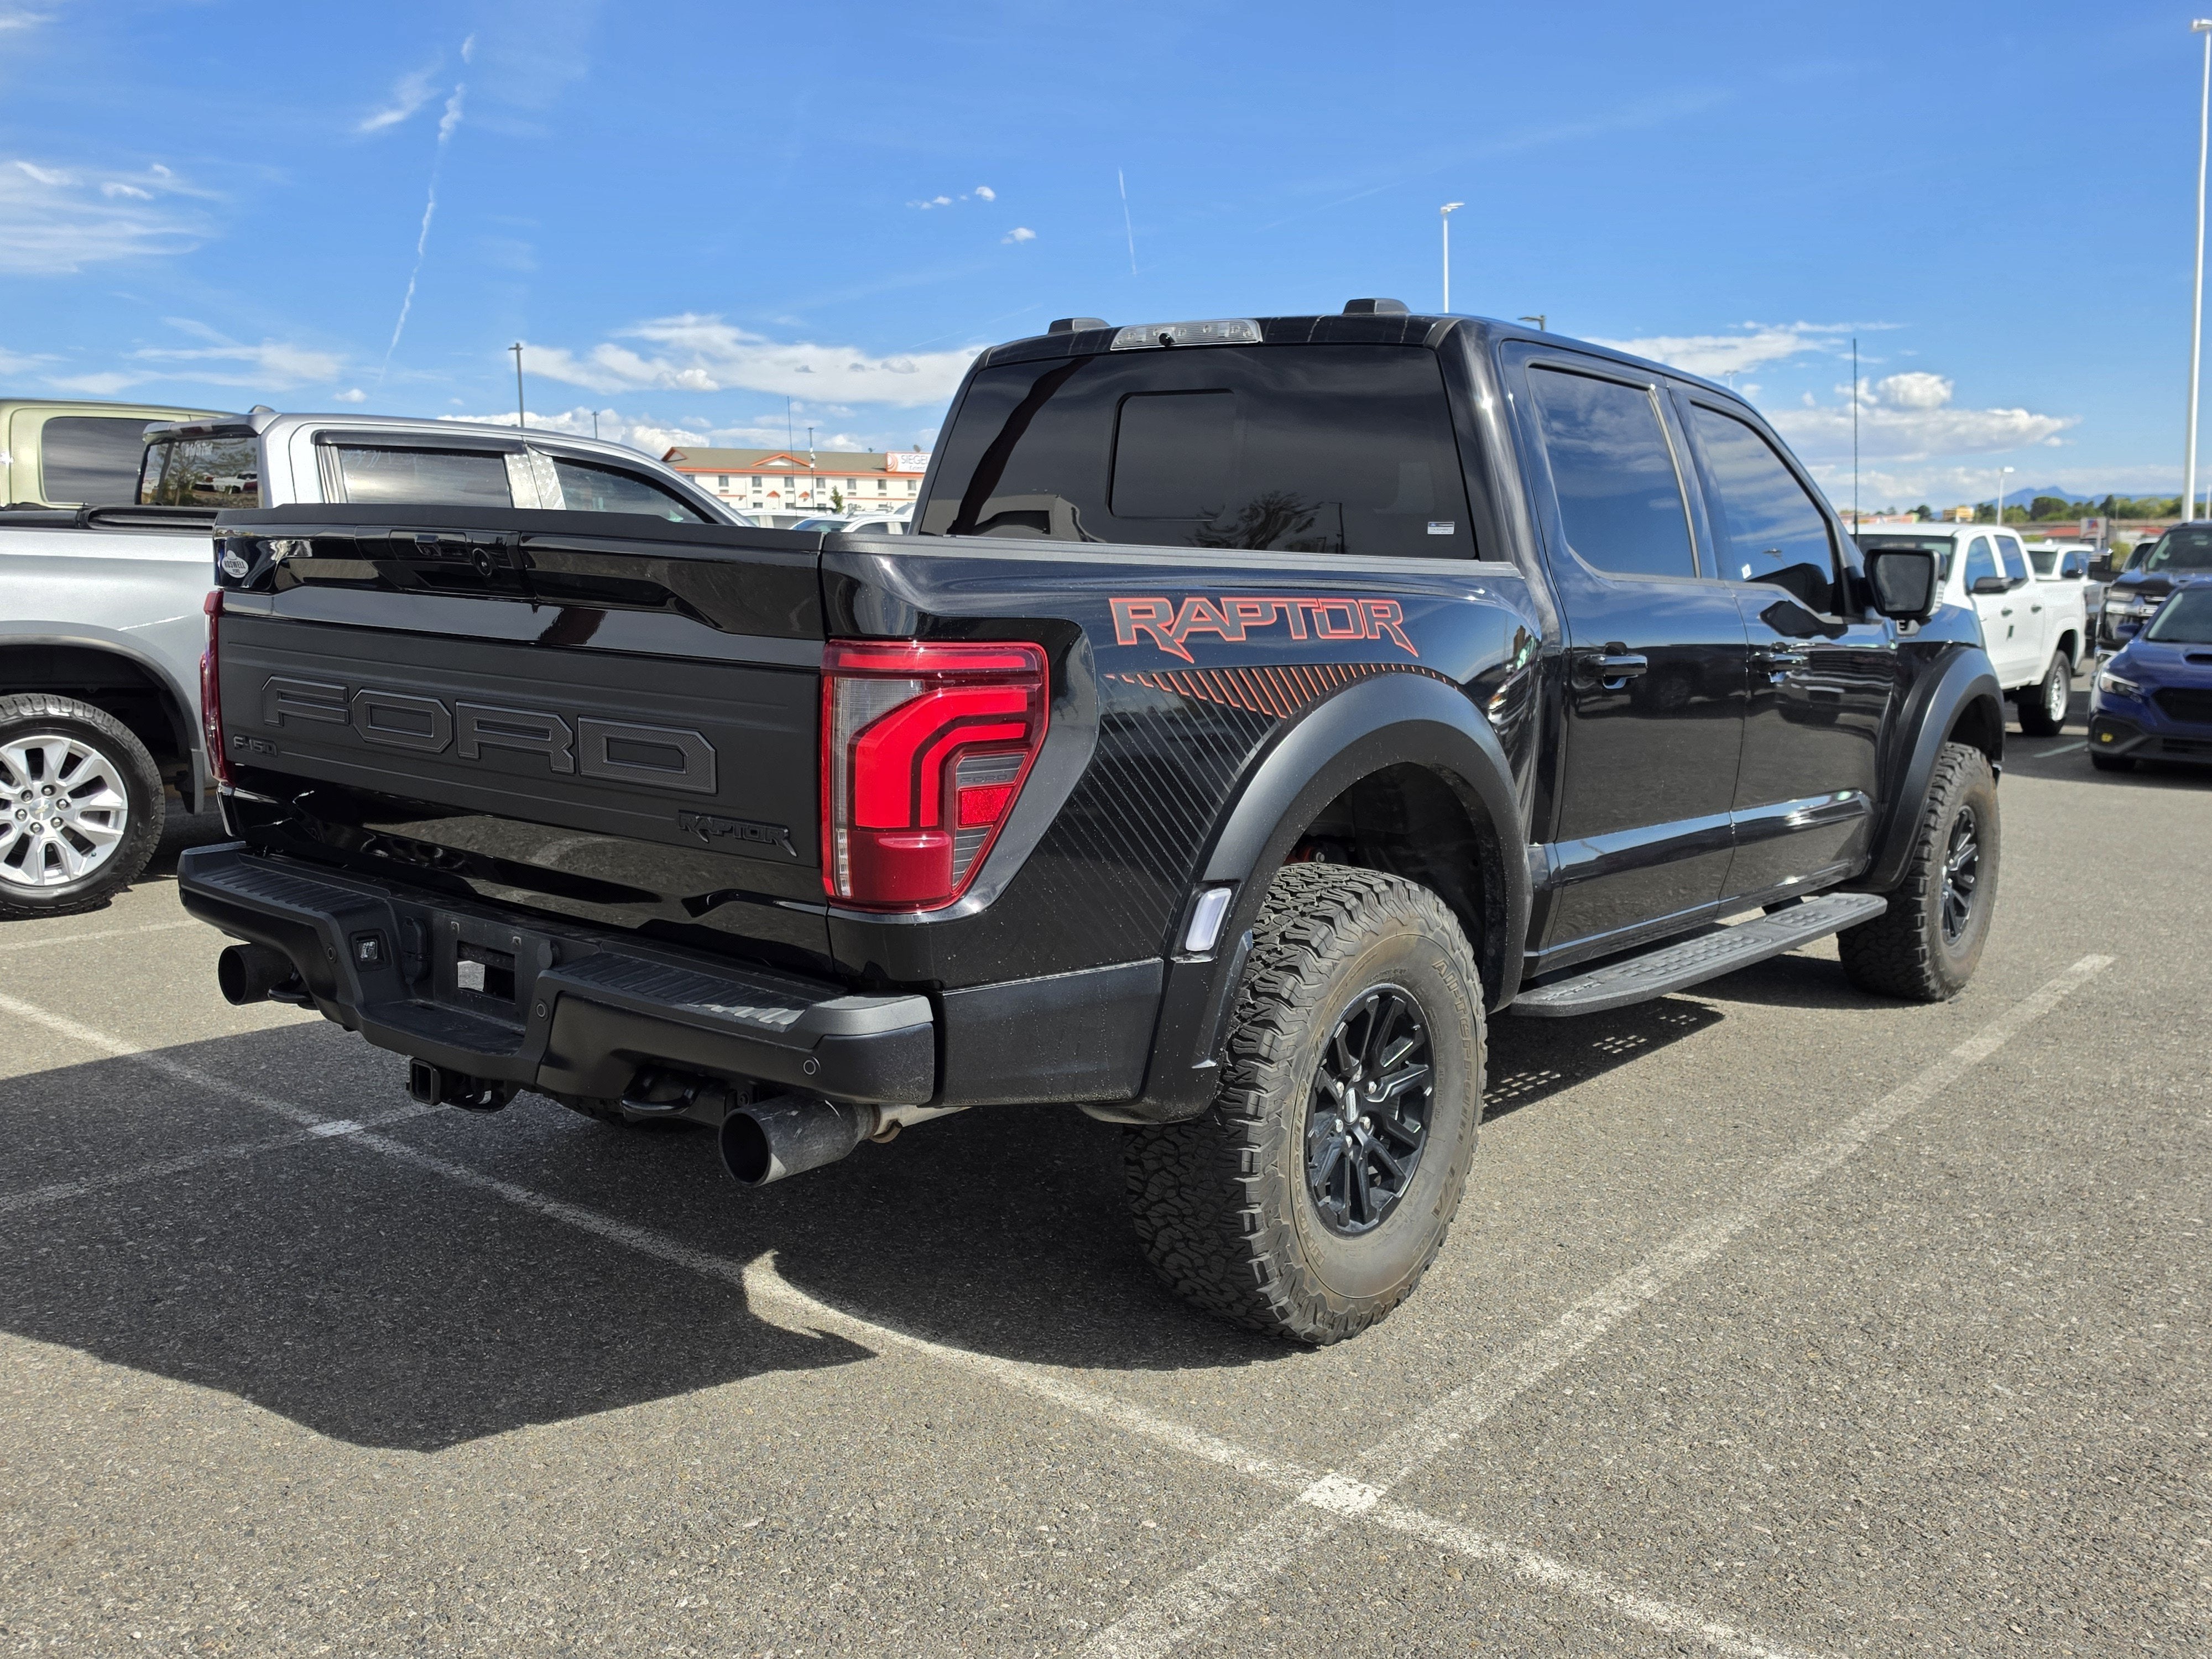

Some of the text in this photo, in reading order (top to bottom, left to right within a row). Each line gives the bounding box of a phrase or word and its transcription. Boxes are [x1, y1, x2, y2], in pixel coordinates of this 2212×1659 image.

[1109, 597, 1397, 664] RAPTOR
[233, 734, 276, 756] F-150
[262, 675, 718, 796] FORD
[960, 775, 1008, 784] FORD
[678, 810, 797, 857] RAPTOR
